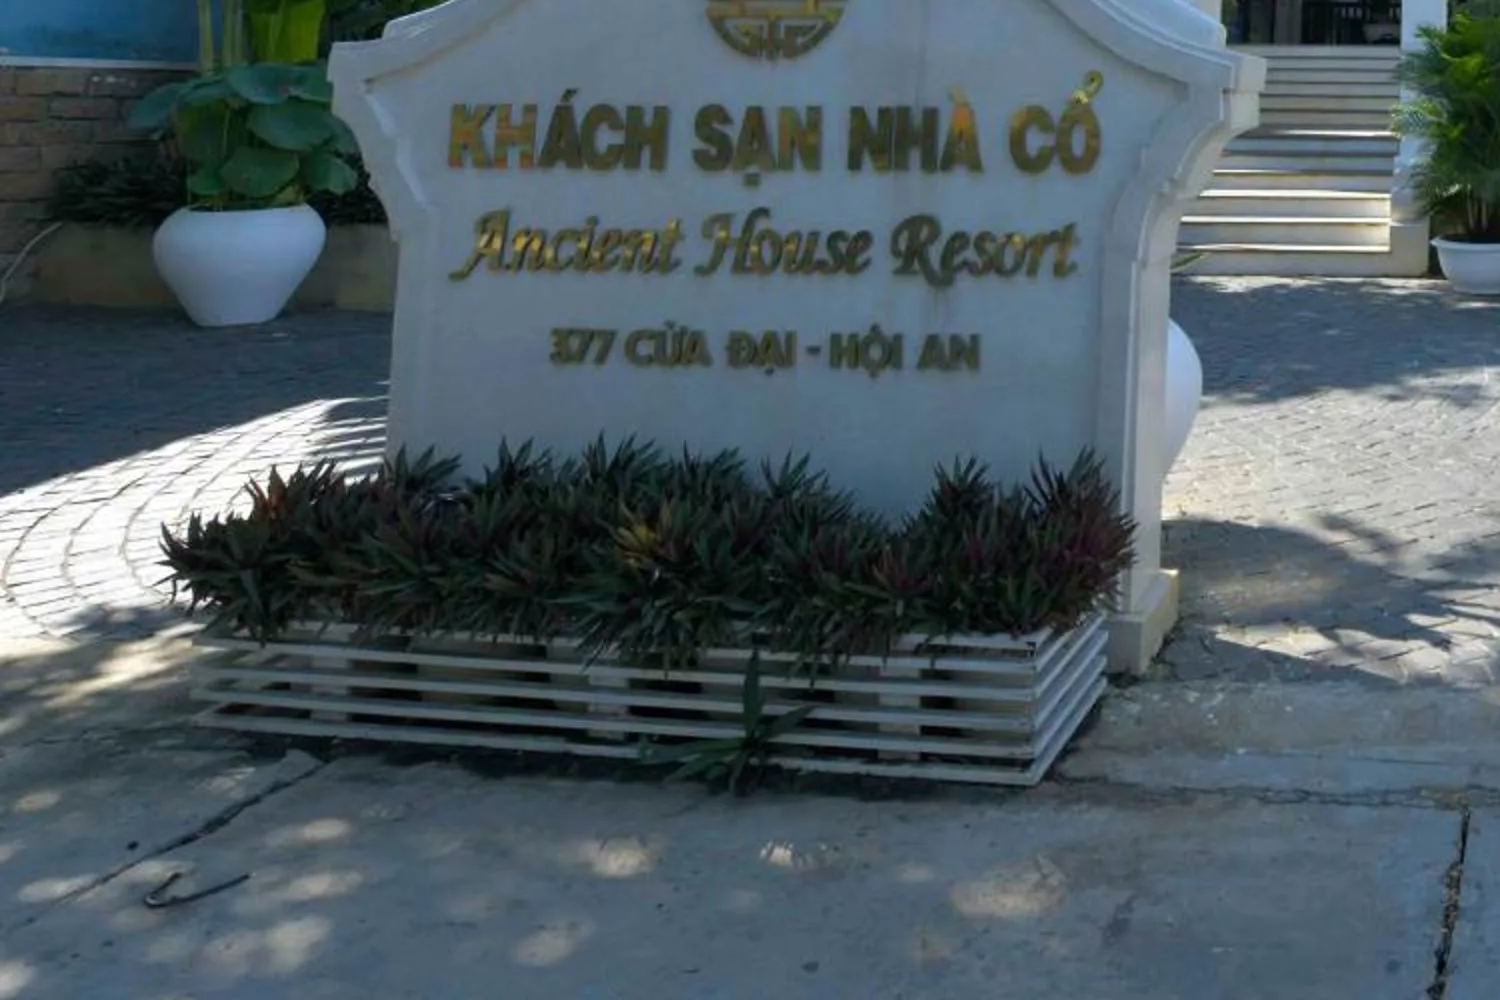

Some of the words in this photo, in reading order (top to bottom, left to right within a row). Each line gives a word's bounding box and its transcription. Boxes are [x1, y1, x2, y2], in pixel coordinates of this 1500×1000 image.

[447, 88, 671, 172] KHÁCH
[692, 104, 823, 188] SẠN
[846, 84, 984, 175] NHÀ
[1009, 70, 1105, 177] CỔ
[449, 206, 684, 282] Ancient
[693, 206, 875, 277] House
[890, 214, 1080, 289] Resort
[550, 327, 618, 366] 377
[726, 329, 797, 376] ĐẠI
[829, 322, 905, 379] HỘI
[916, 332, 983, 371] AN
